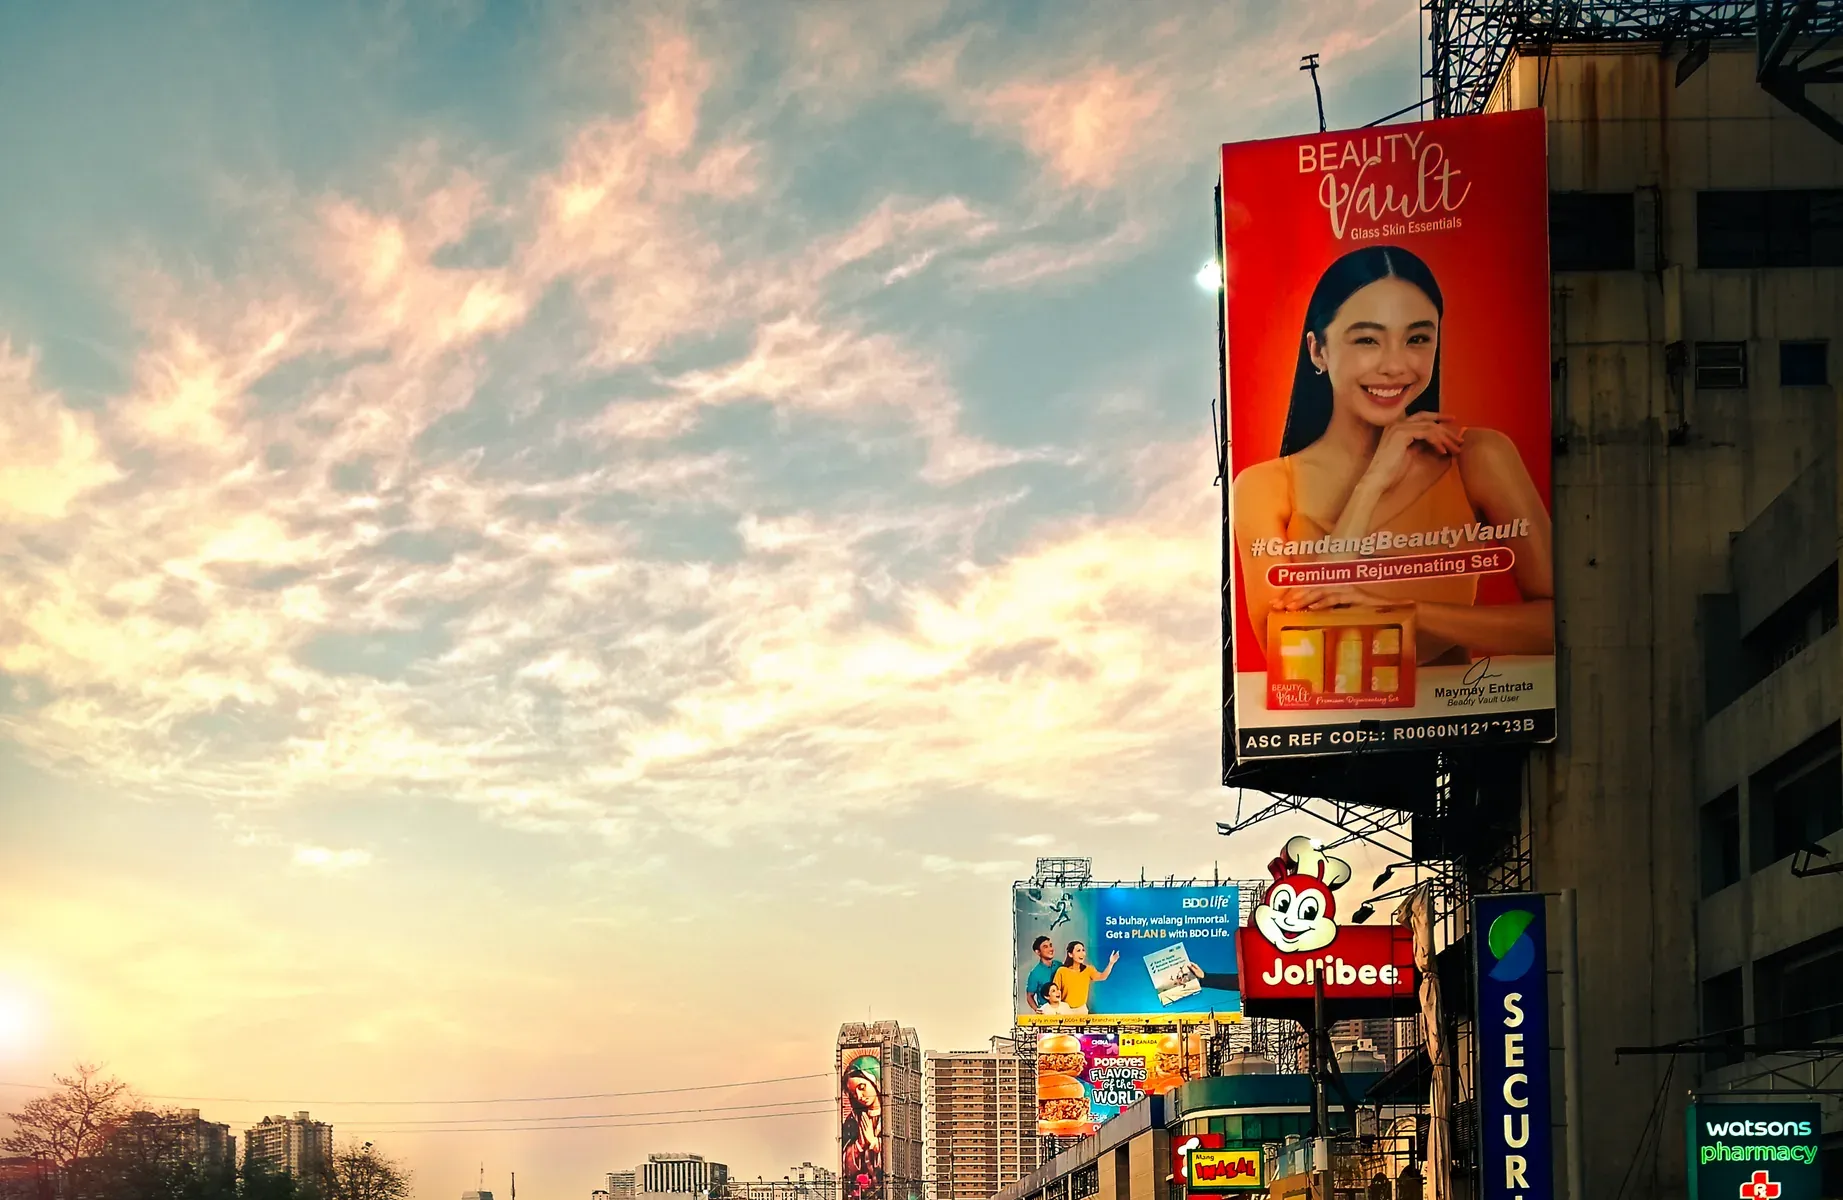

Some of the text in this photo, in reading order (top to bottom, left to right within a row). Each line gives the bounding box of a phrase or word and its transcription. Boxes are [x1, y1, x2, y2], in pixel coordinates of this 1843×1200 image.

[1298, 131, 1424, 173] BEAUTY
[1319, 143, 1472, 240] Vault
[1351, 216, 1462, 240] Glass Skin Essentials
[1251, 518, 1530, 557] #GandangBeautyVault
[1278, 554, 1499, 583] Premium Rejuvenating Set
[1272, 684, 1302, 692] BEAUTY
[1276, 687, 1311, 706] Vault
[1435, 681, 1534, 699] Maymay Entrata
[1447, 694, 1520, 707] Beauty Vault User
[1245, 734, 1282, 749] ASC
[1288, 732, 1323, 747] REF
[1393, 718, 1535, 742] R0060N12123B
[1182, 895, 1229, 910] BDO life
[1105, 916, 1117, 925] Sa
[1119, 916, 1149, 927] buhay,
[1150, 915, 1183, 927] walang
[1105, 927, 1230, 939] Get a PLAN B with BDO Life.
[1090, 1068, 1147, 1082] FLAVORS
[1103, 1079, 1134, 1091] of the
[1706, 1118, 1812, 1138] watsons
[1195, 1154, 1214, 1162] Mang
[1700, 1140, 1818, 1165] pharmacy
